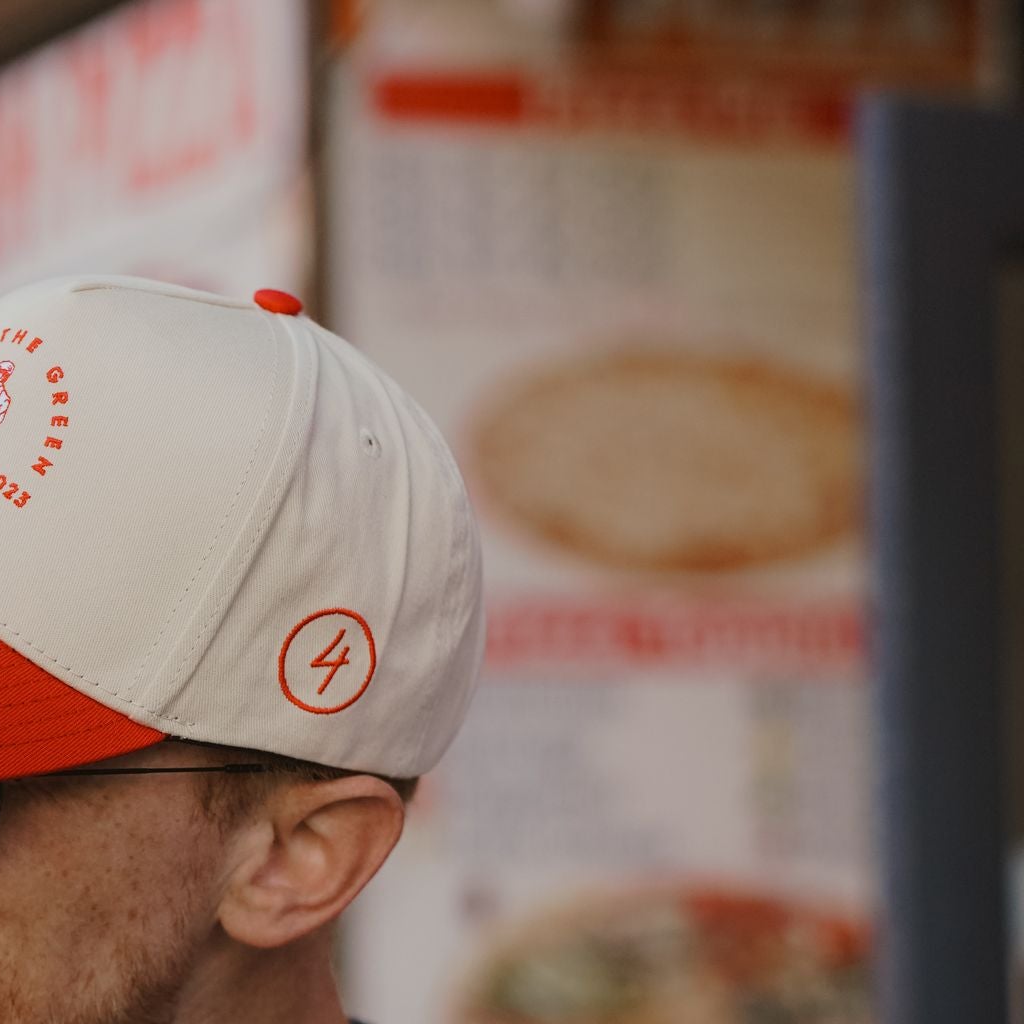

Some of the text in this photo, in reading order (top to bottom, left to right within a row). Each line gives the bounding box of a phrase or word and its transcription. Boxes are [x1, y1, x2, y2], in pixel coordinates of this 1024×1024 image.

[0, 327, 69, 476] THE GREEN
[311, 628, 350, 696] 4
